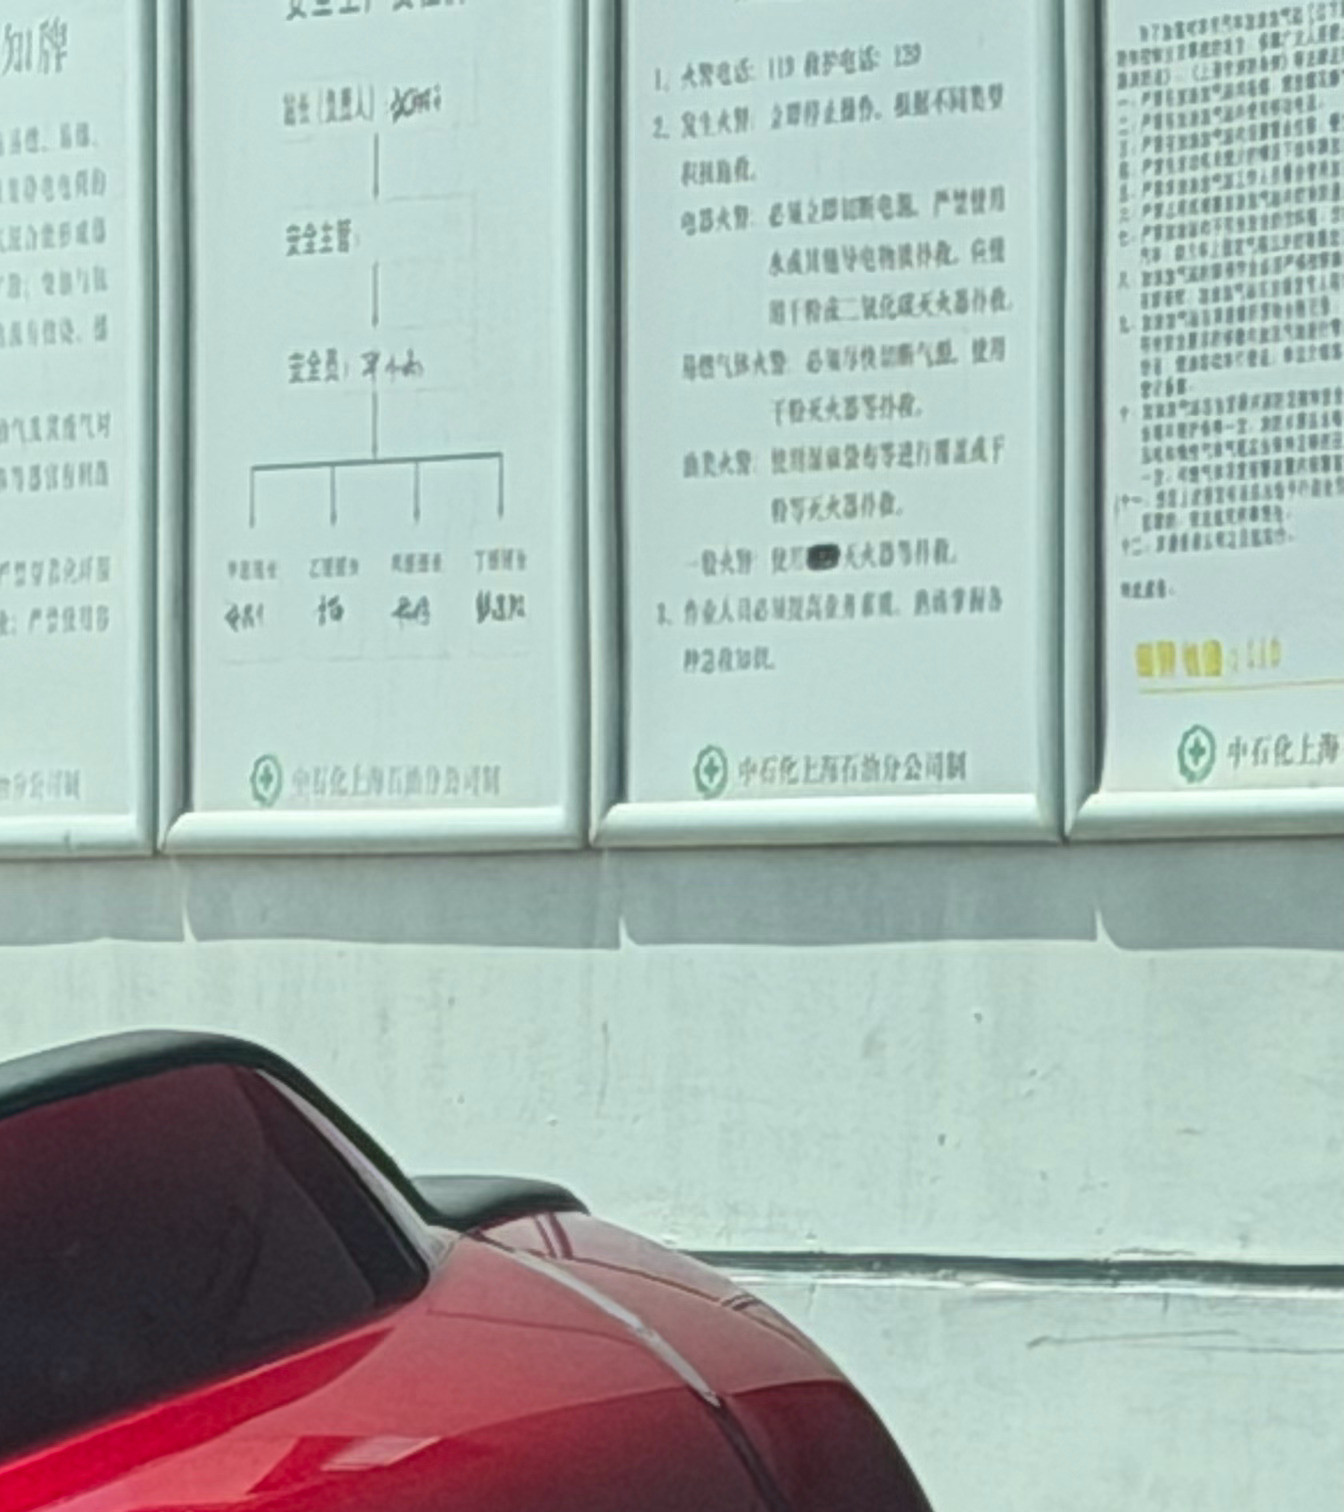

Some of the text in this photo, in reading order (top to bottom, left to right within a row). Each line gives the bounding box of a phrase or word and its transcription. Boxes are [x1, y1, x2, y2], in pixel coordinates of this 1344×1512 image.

[738, 750, 967, 786] 中石化上海石油分公司制
